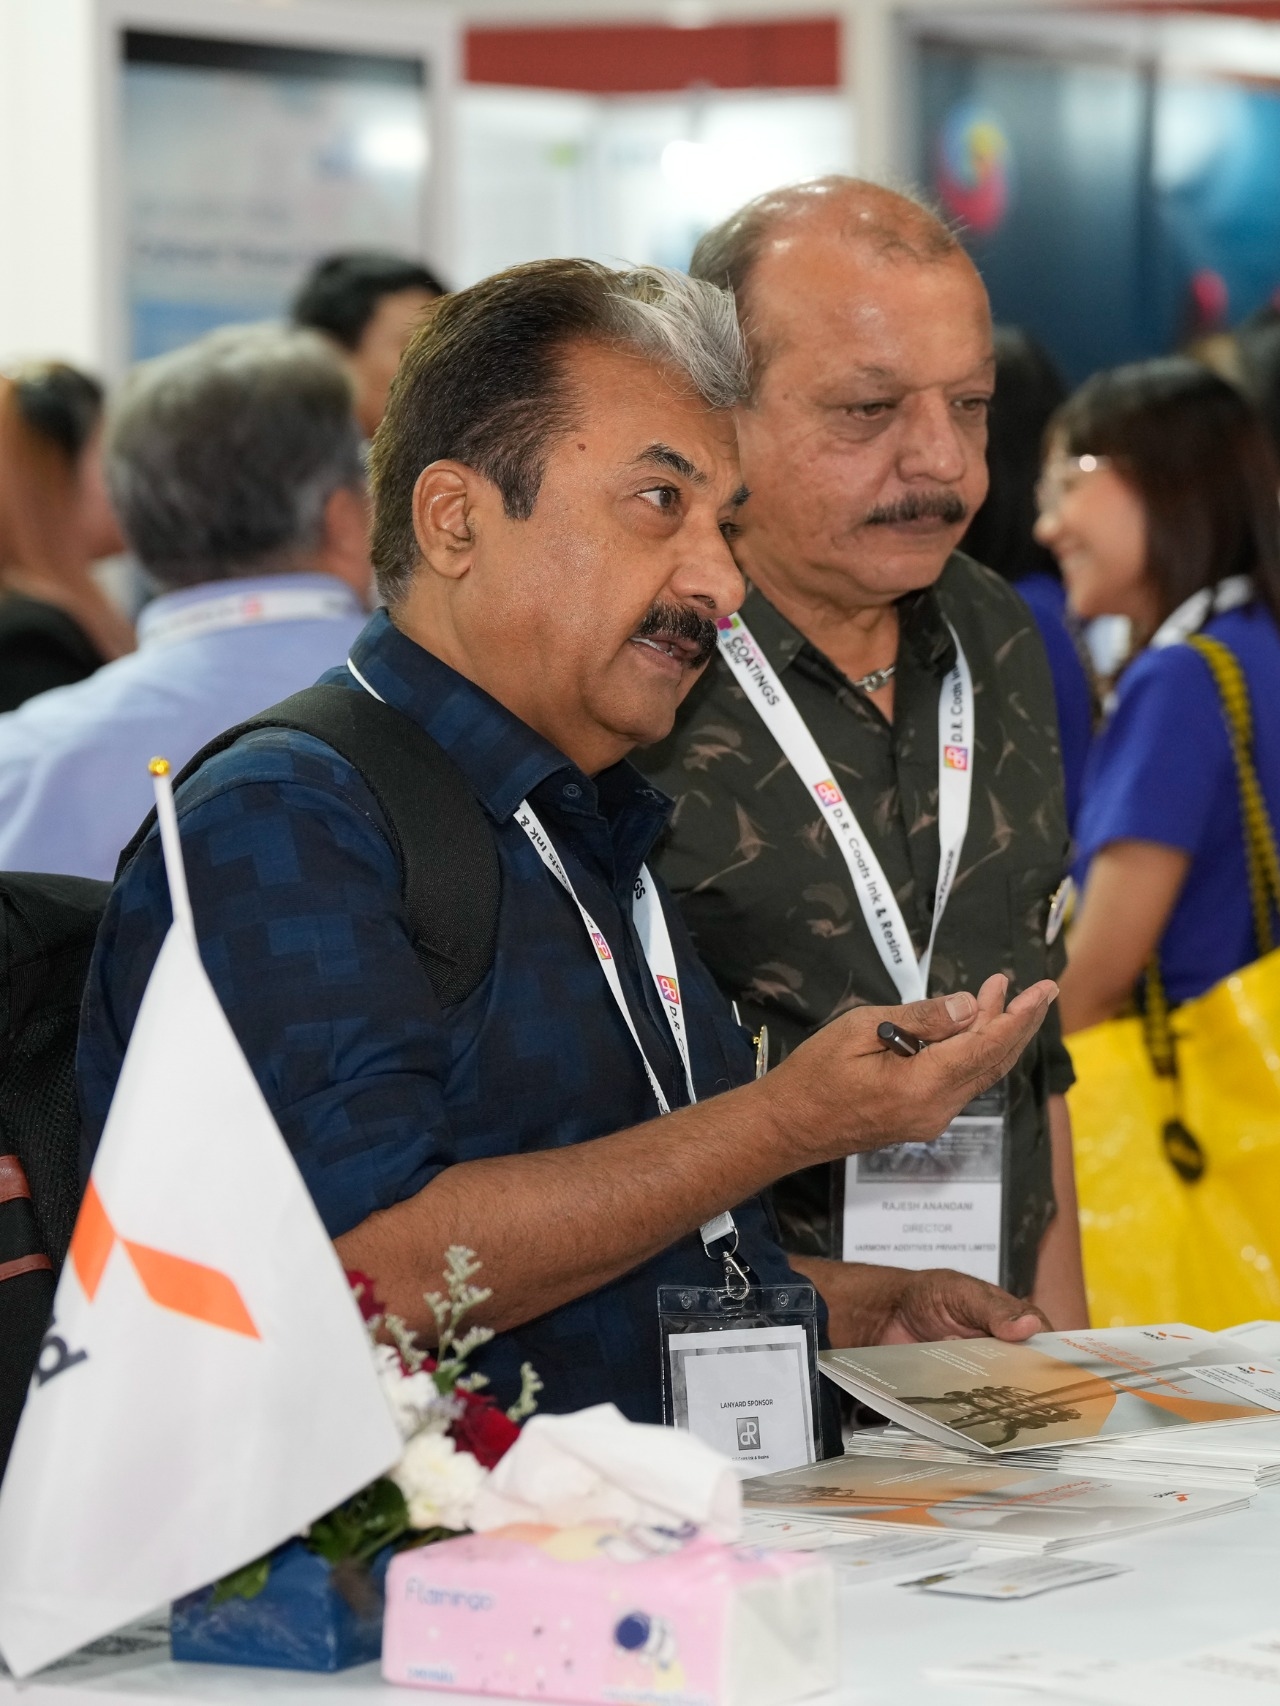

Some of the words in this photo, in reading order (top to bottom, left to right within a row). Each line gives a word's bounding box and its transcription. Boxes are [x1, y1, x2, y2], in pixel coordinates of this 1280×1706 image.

[732, 636, 780, 706] COATINGS
[530, 827, 548, 852] Ink
[833, 808, 850, 836] D.R.
[849, 838, 870, 879] Coats
[867, 881, 881, 906] Ink
[875, 907, 887, 918] &
[881, 921, 903, 965] Resins
[882, 1201, 920, 1211] RAJESH
[922, 1201, 973, 1211] ANANDANI
[902, 1223, 953, 1233] DIRECTOR
[720, 1401, 747, 1409] LANYARD
[747, 1399, 774, 1407] SPONSOR
